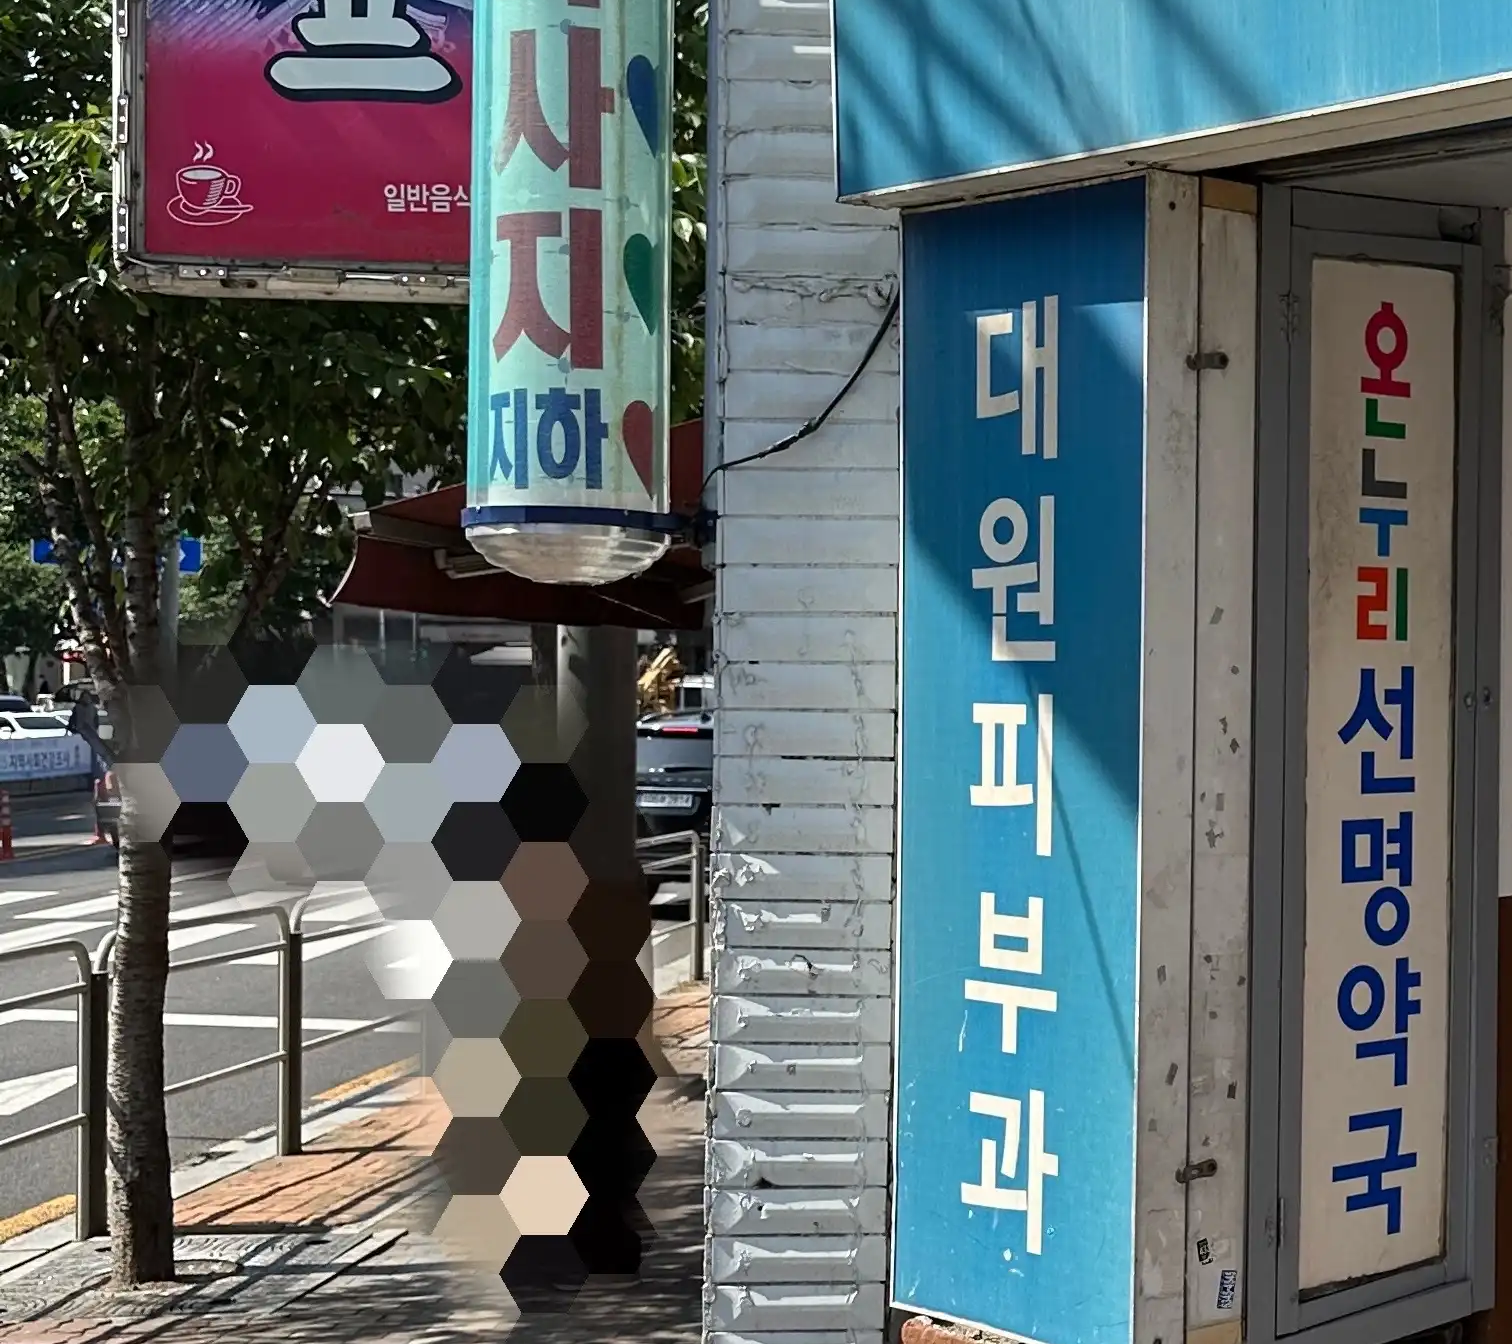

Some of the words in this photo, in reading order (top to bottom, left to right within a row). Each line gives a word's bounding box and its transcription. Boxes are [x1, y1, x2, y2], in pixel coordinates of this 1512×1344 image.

[489, 387, 607, 489] 지하
[960, 294, 1060, 1256] 대원피부과
[1332, 664, 1420, 1236] 선명약국
